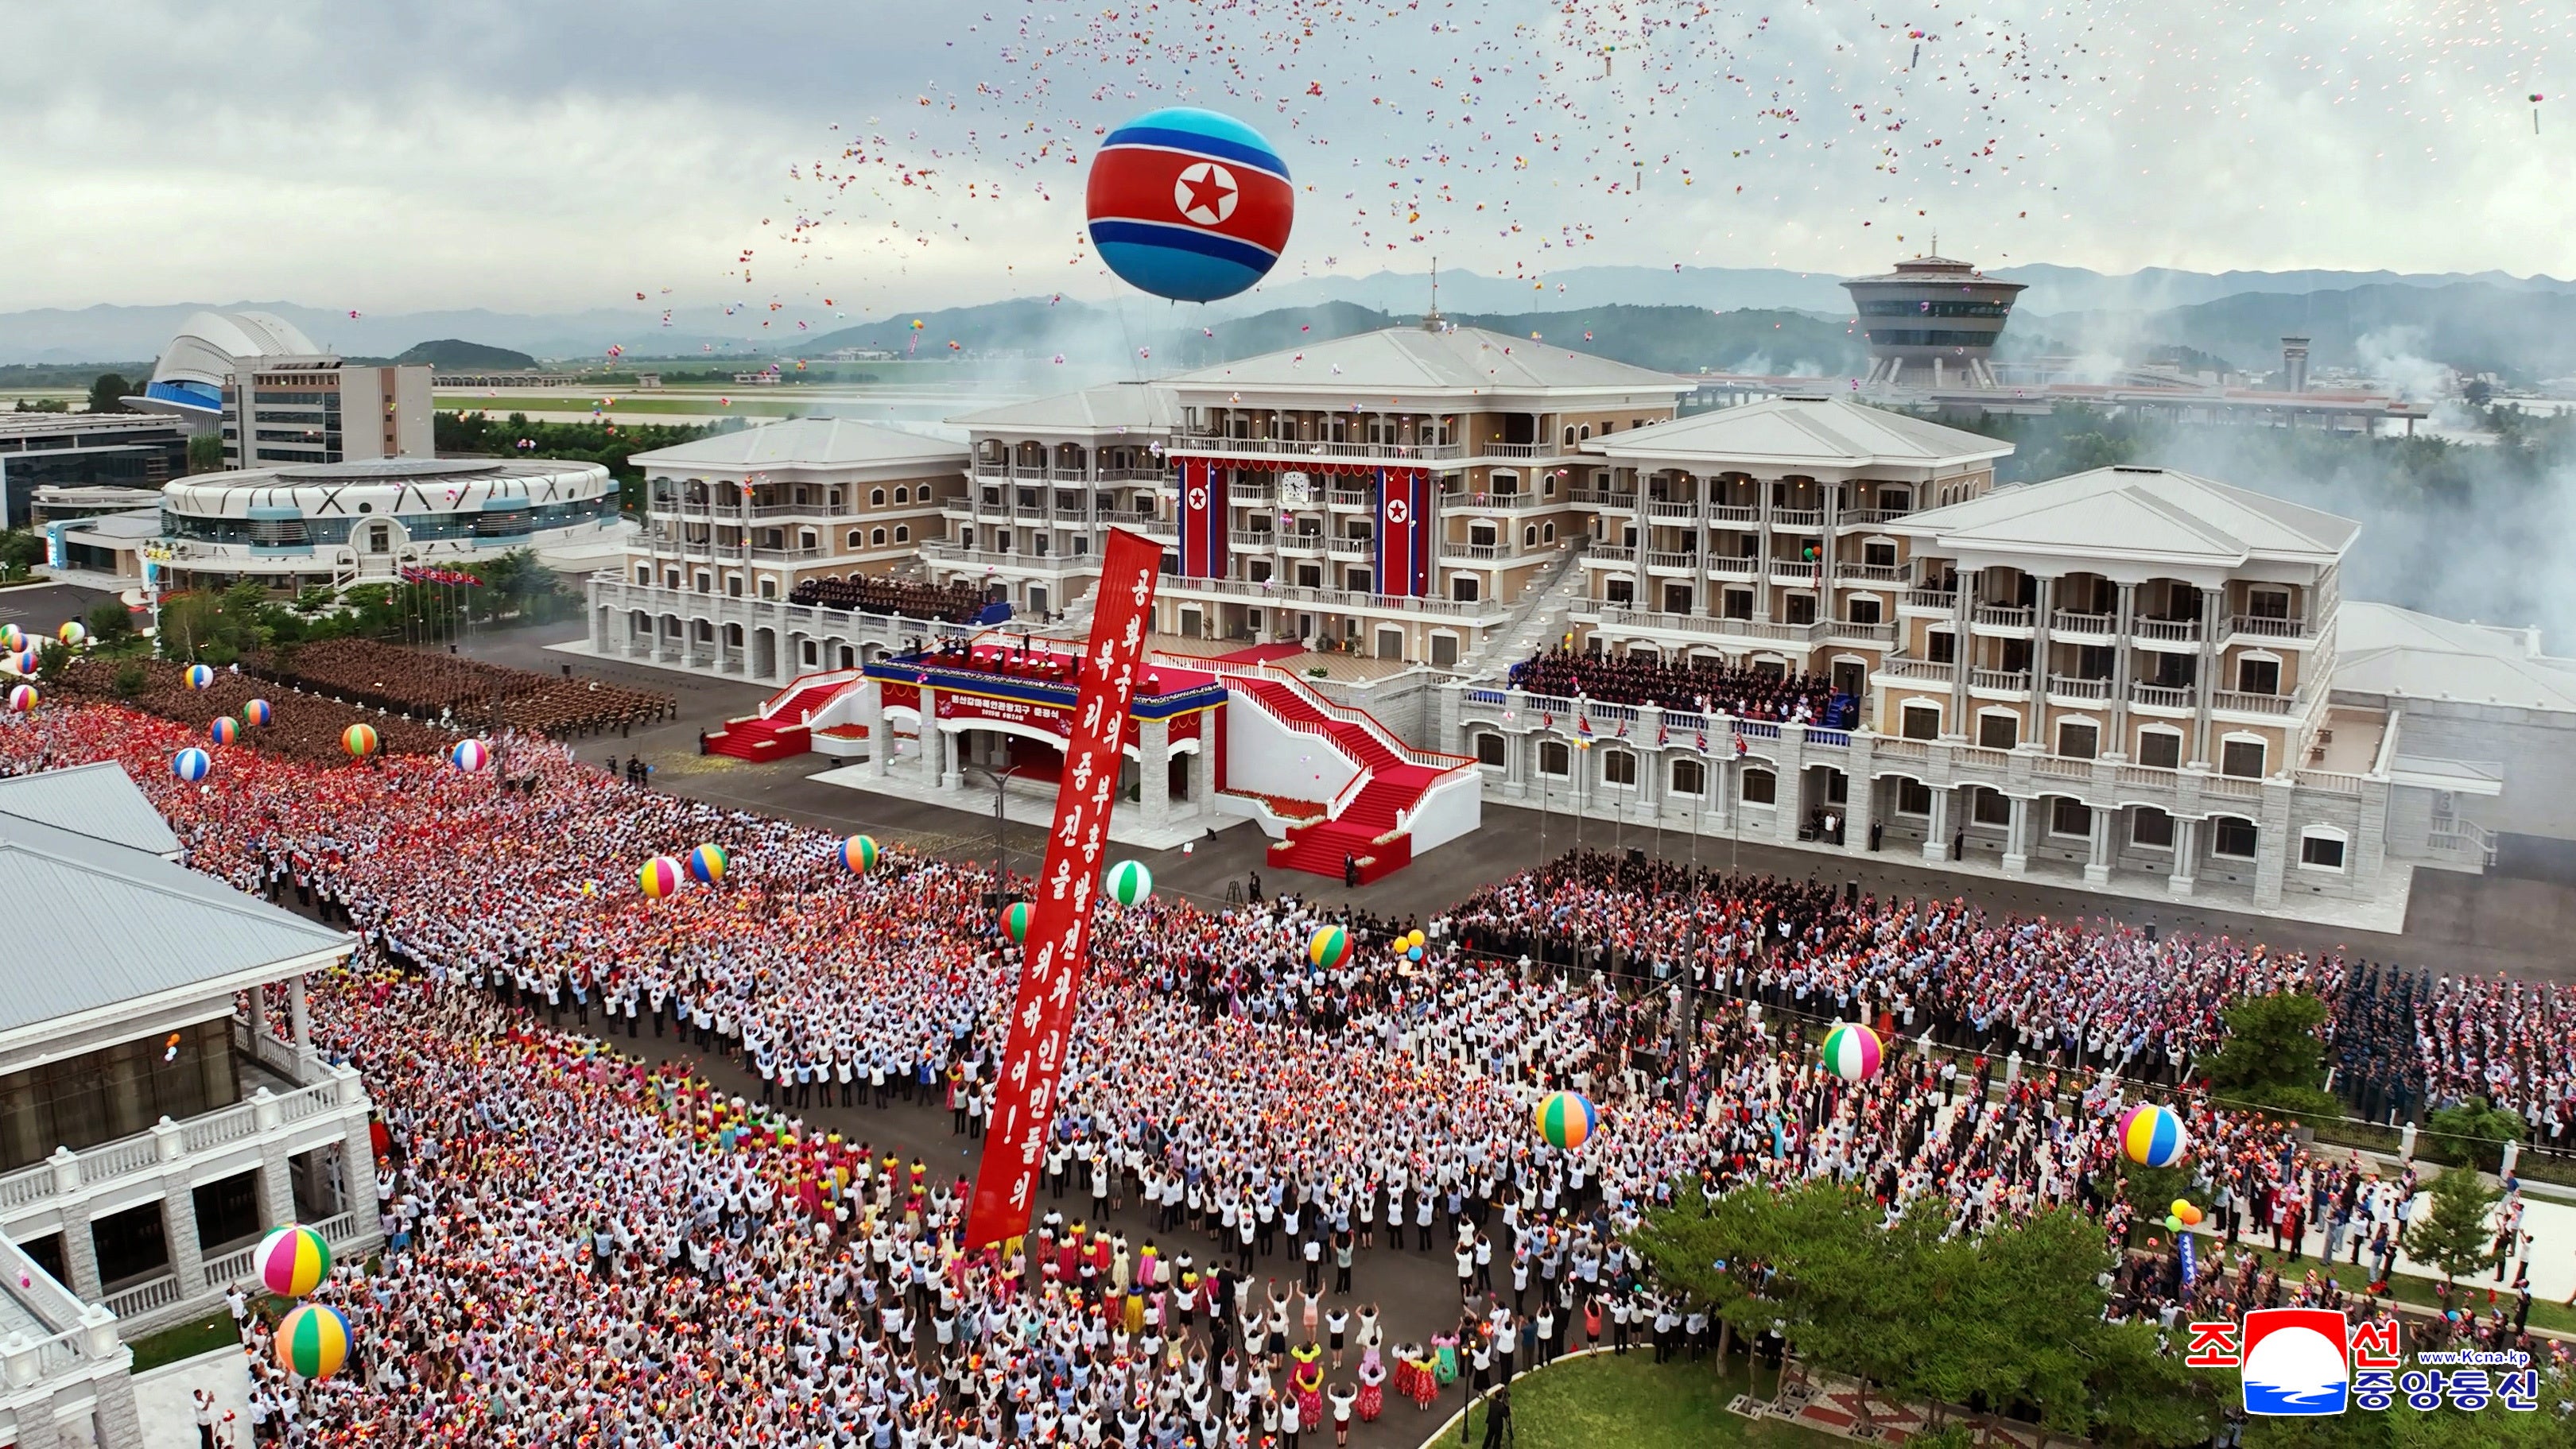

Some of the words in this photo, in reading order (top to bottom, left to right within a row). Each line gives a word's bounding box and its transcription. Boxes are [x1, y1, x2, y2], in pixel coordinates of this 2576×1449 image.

[1104, 569, 1149, 753] 공화국의
[1051, 639, 1114, 899] 복리증진을
[1049, 775, 1110, 1009] 부흥발전과
[1010, 1030, 1059, 1211] 인민들의
